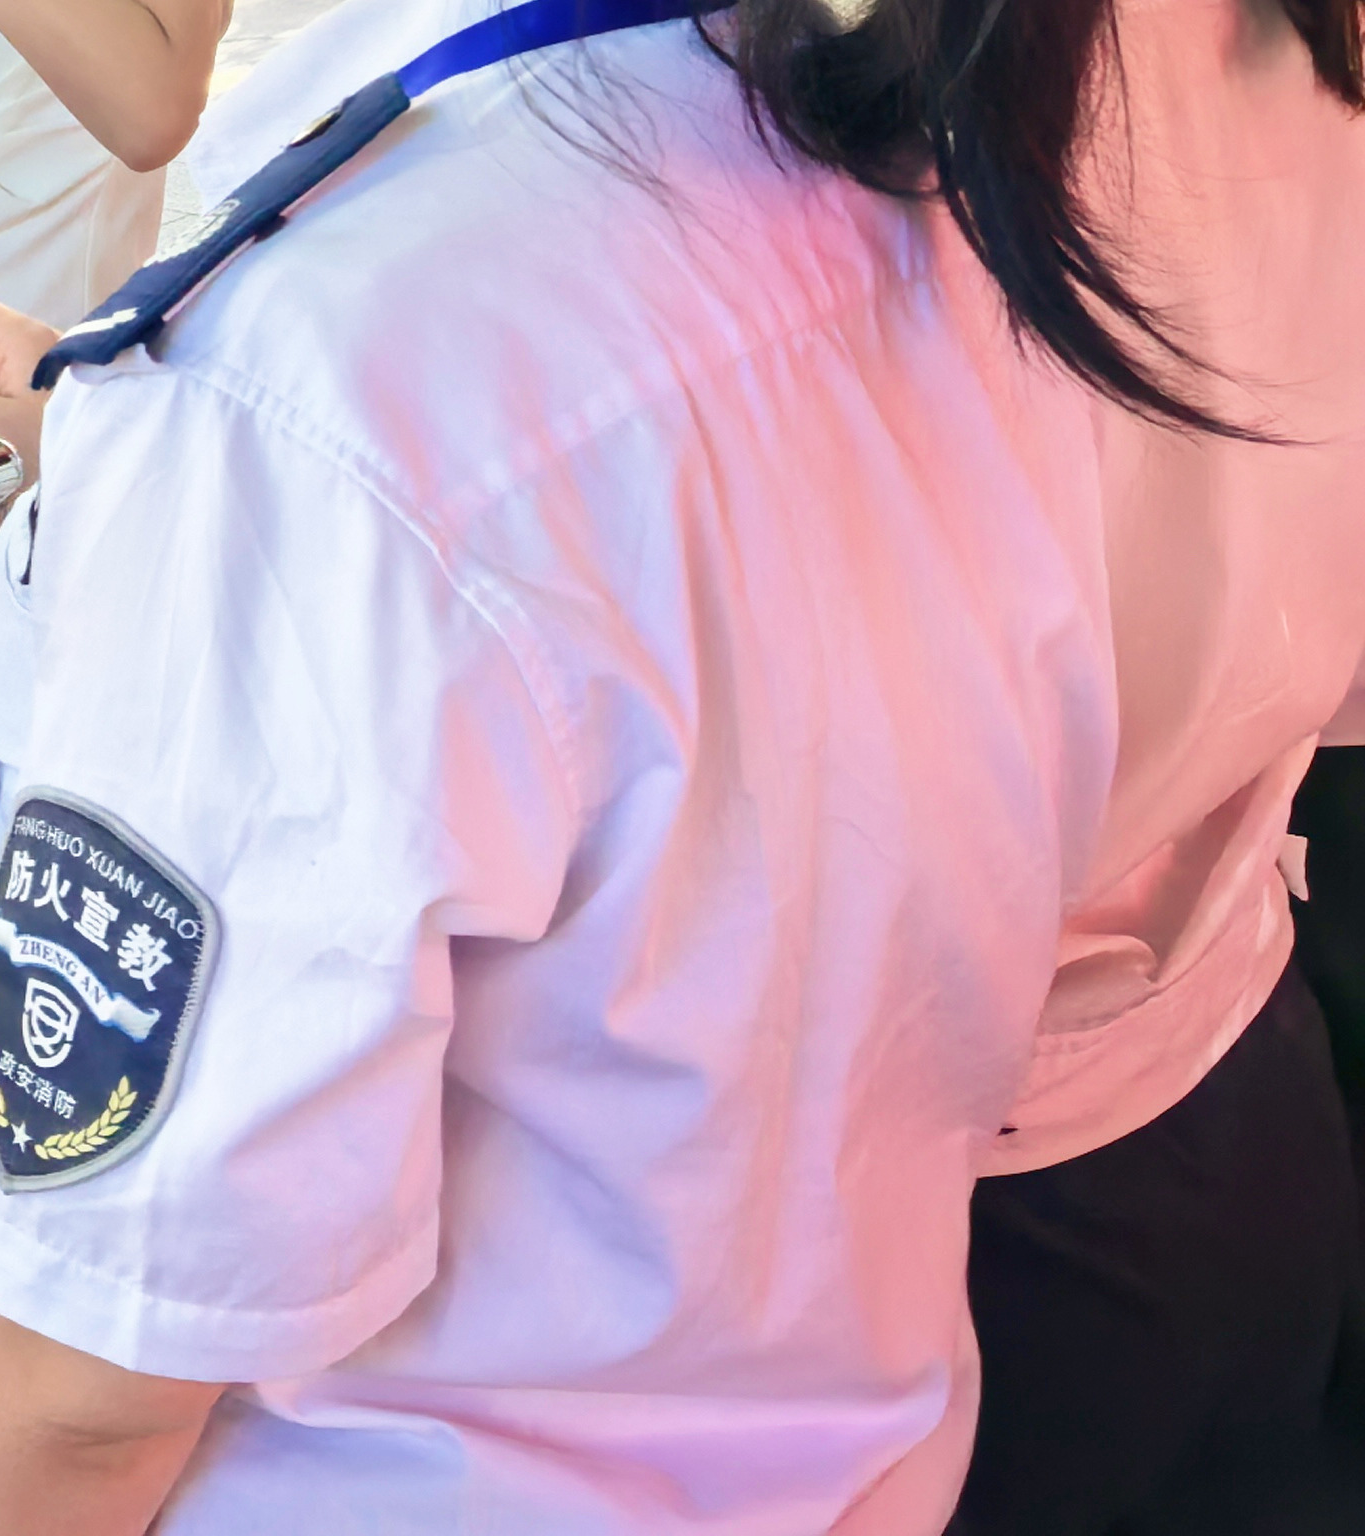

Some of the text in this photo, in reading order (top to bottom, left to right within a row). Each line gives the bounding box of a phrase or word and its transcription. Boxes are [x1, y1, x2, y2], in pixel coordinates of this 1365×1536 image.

[5, 850, 173, 992] 防火宣教
[85, 845, 144, 898] XUAN
[143, 892, 197, 940] JIAO
[19, 939, 106, 1005] ZHENG AN
